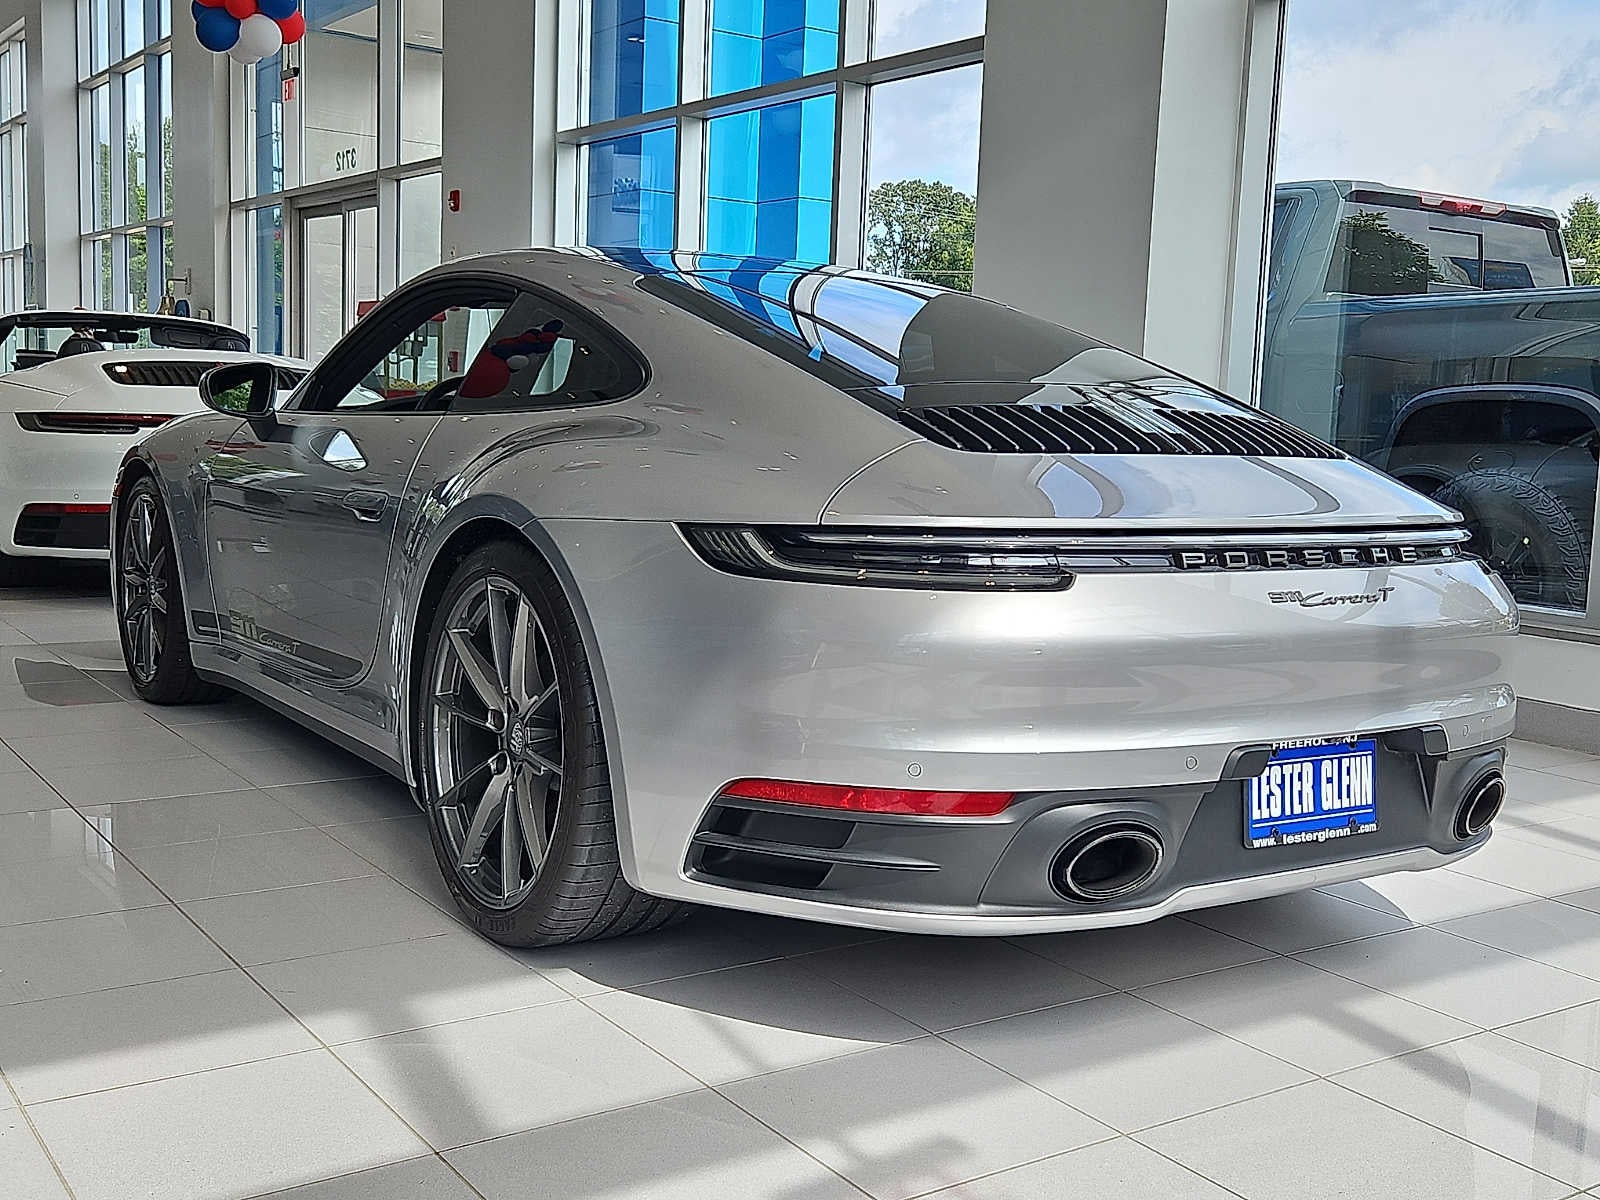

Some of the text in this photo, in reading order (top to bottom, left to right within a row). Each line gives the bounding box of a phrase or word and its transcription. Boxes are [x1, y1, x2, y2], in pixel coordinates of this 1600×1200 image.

[1182, 547, 1417, 568] PORSCHE
[1267, 590, 1302, 604] 911
[229, 608, 258, 640] 911
[1252, 756, 1372, 820] LESTER GLENN
